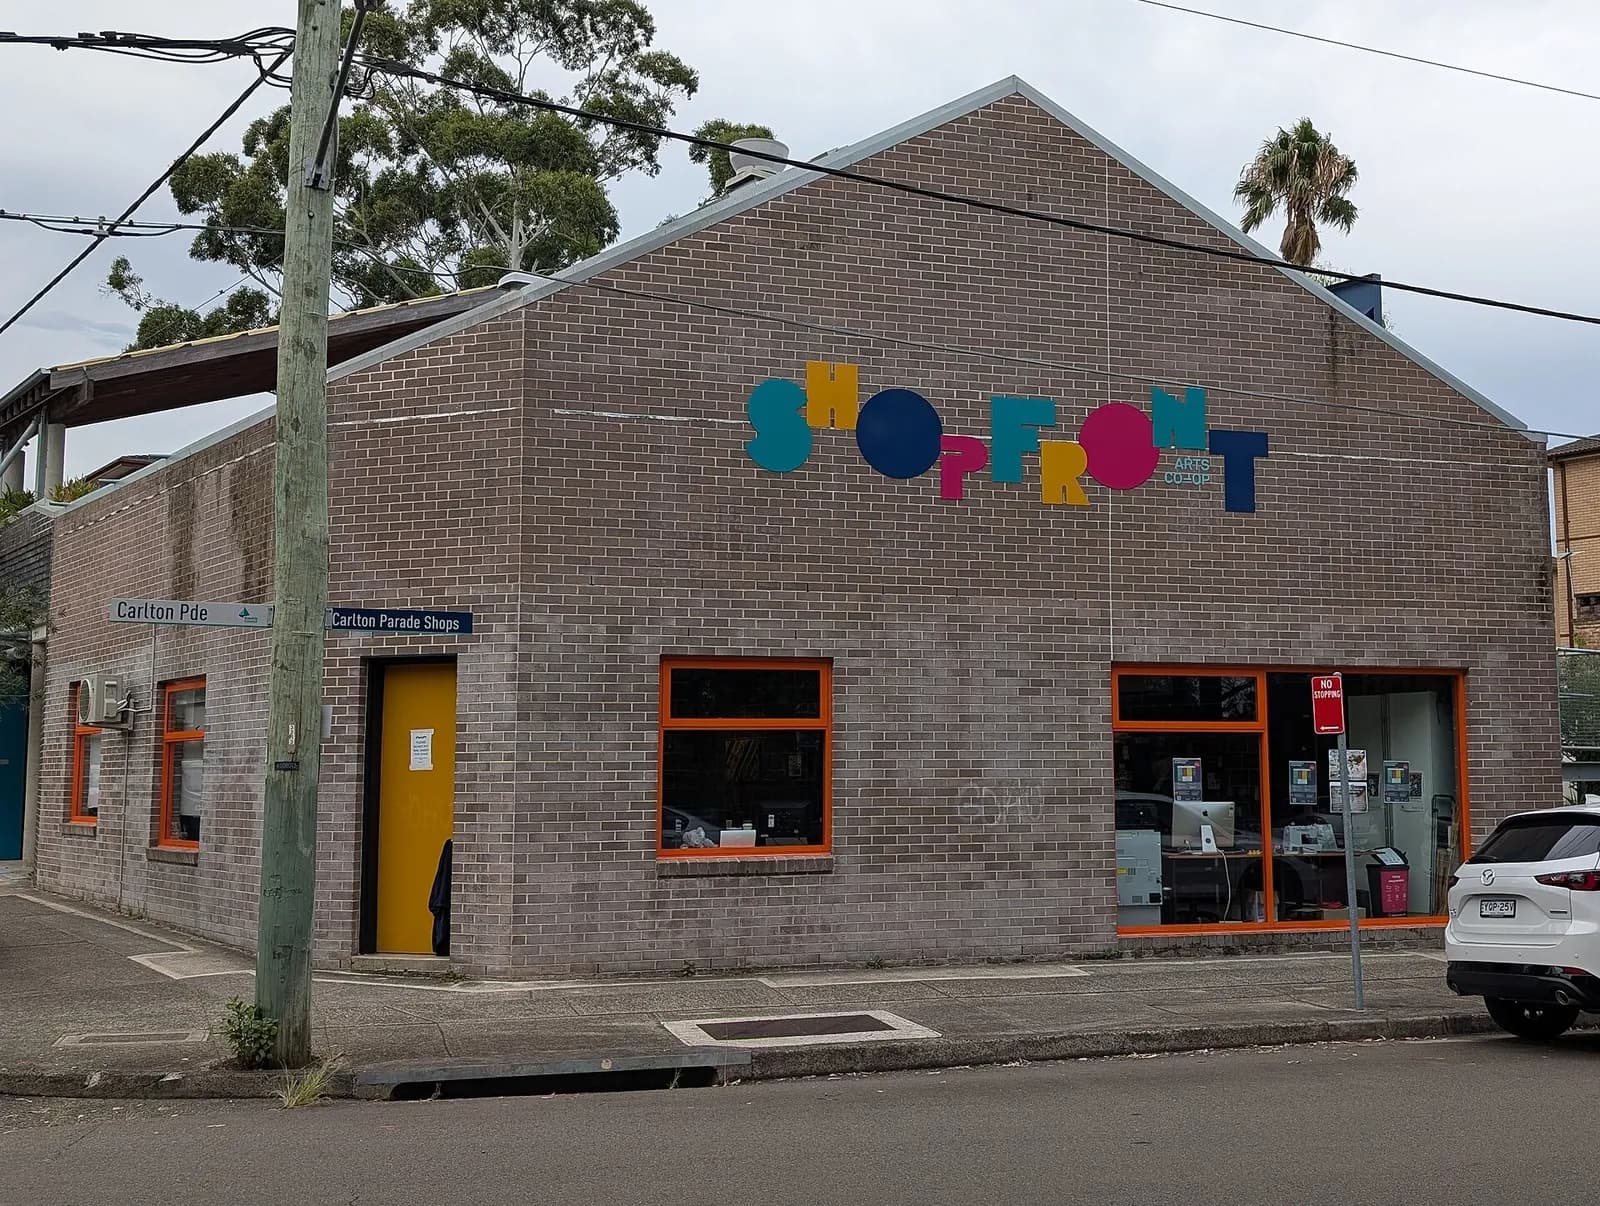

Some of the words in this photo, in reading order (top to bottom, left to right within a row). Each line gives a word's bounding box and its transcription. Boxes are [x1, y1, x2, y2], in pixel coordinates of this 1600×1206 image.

[747, 361, 1268, 512] SHOPFRONT
[1175, 457, 1210, 471] ARTS
[1164, 471, 1210, 486] CO-OP
[117, 601, 174, 620] Carlton
[180, 603, 207, 621] Pde
[333, 612, 375, 628] Carlton
[380, 614, 420, 629] Parade
[424, 615, 460, 633] Shops
[1320, 679, 1333, 689] NO
[1314, 690, 1341, 699] STOPPING
